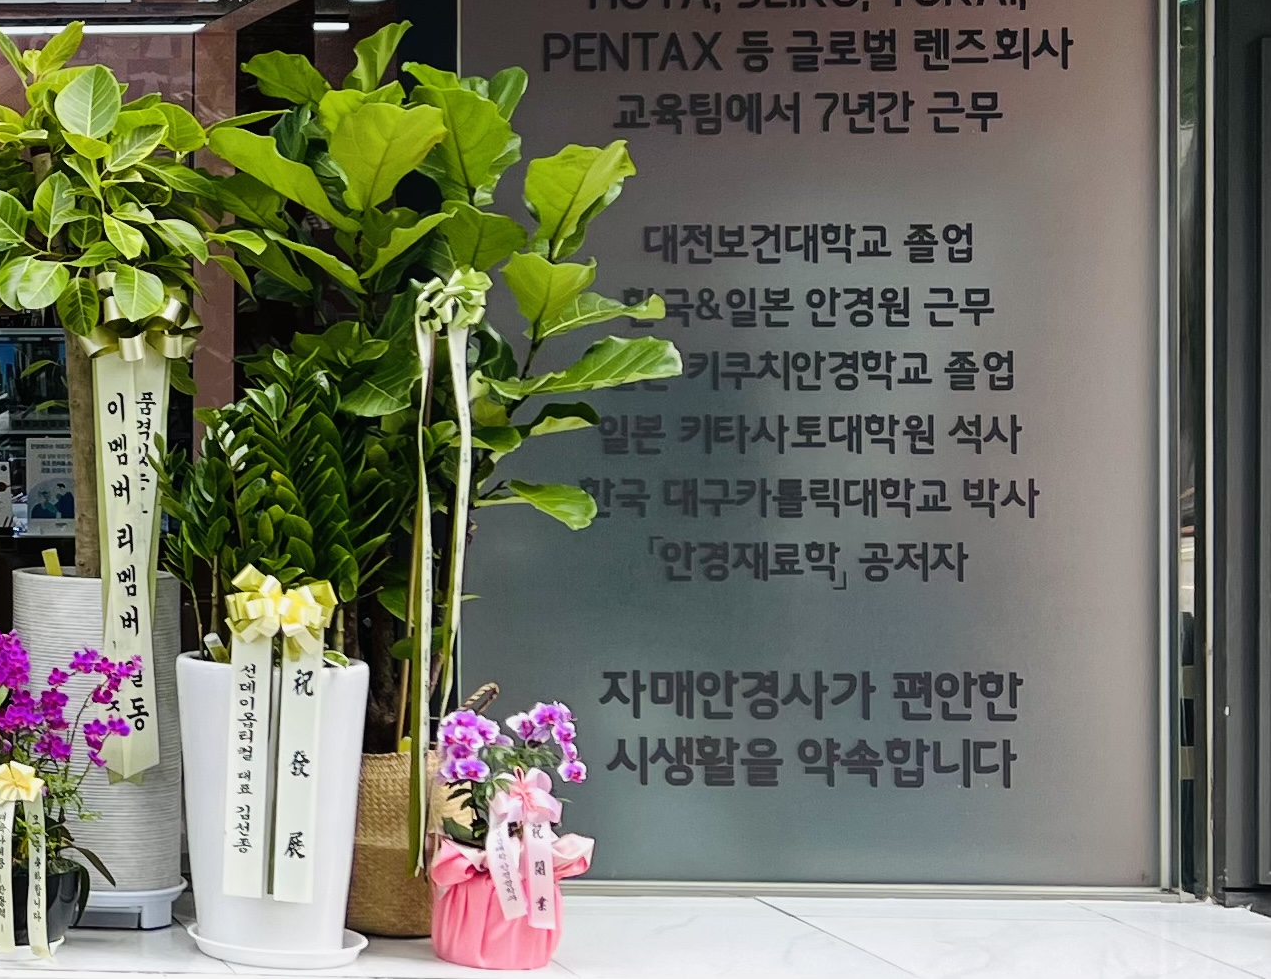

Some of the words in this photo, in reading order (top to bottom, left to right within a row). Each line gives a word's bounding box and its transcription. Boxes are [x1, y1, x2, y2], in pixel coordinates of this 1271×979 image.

[542, 30, 723, 73] PENTAX
[735, 31, 774, 72] 등
[786, 29, 898, 73] 글로벌
[913, 26, 1073, 71] 렌즈회사
[613, 91, 800, 136] 교육팀에서
[815, 91, 914, 136] 7년간
[927, 91, 1003, 134] 근무
[644, 223, 893, 265] 대전보건대학교
[903, 223, 976, 265] 졸업
[806, 286, 911, 329] 안경원
[923, 287, 996, 328] 근무
[686, 350, 933, 393] 키쿠치안경학교
[944, 349, 1017, 392] 졸업
[598, 414, 666, 455] 일본
[680, 414, 937, 456] 키타사토대학원
[948, 414, 1023, 455] 석사
[663, 477, 952, 520] 대구카톨릭대학교
[963, 476, 1040, 520] 박사
[859, 540, 969, 583] 공저자
[599, 670, 876, 721] 자매안경사가
[893, 670, 1024, 721] 편안한
[605, 735, 783, 789] 시생활을
[798, 735, 1018, 790] 약속합니다
